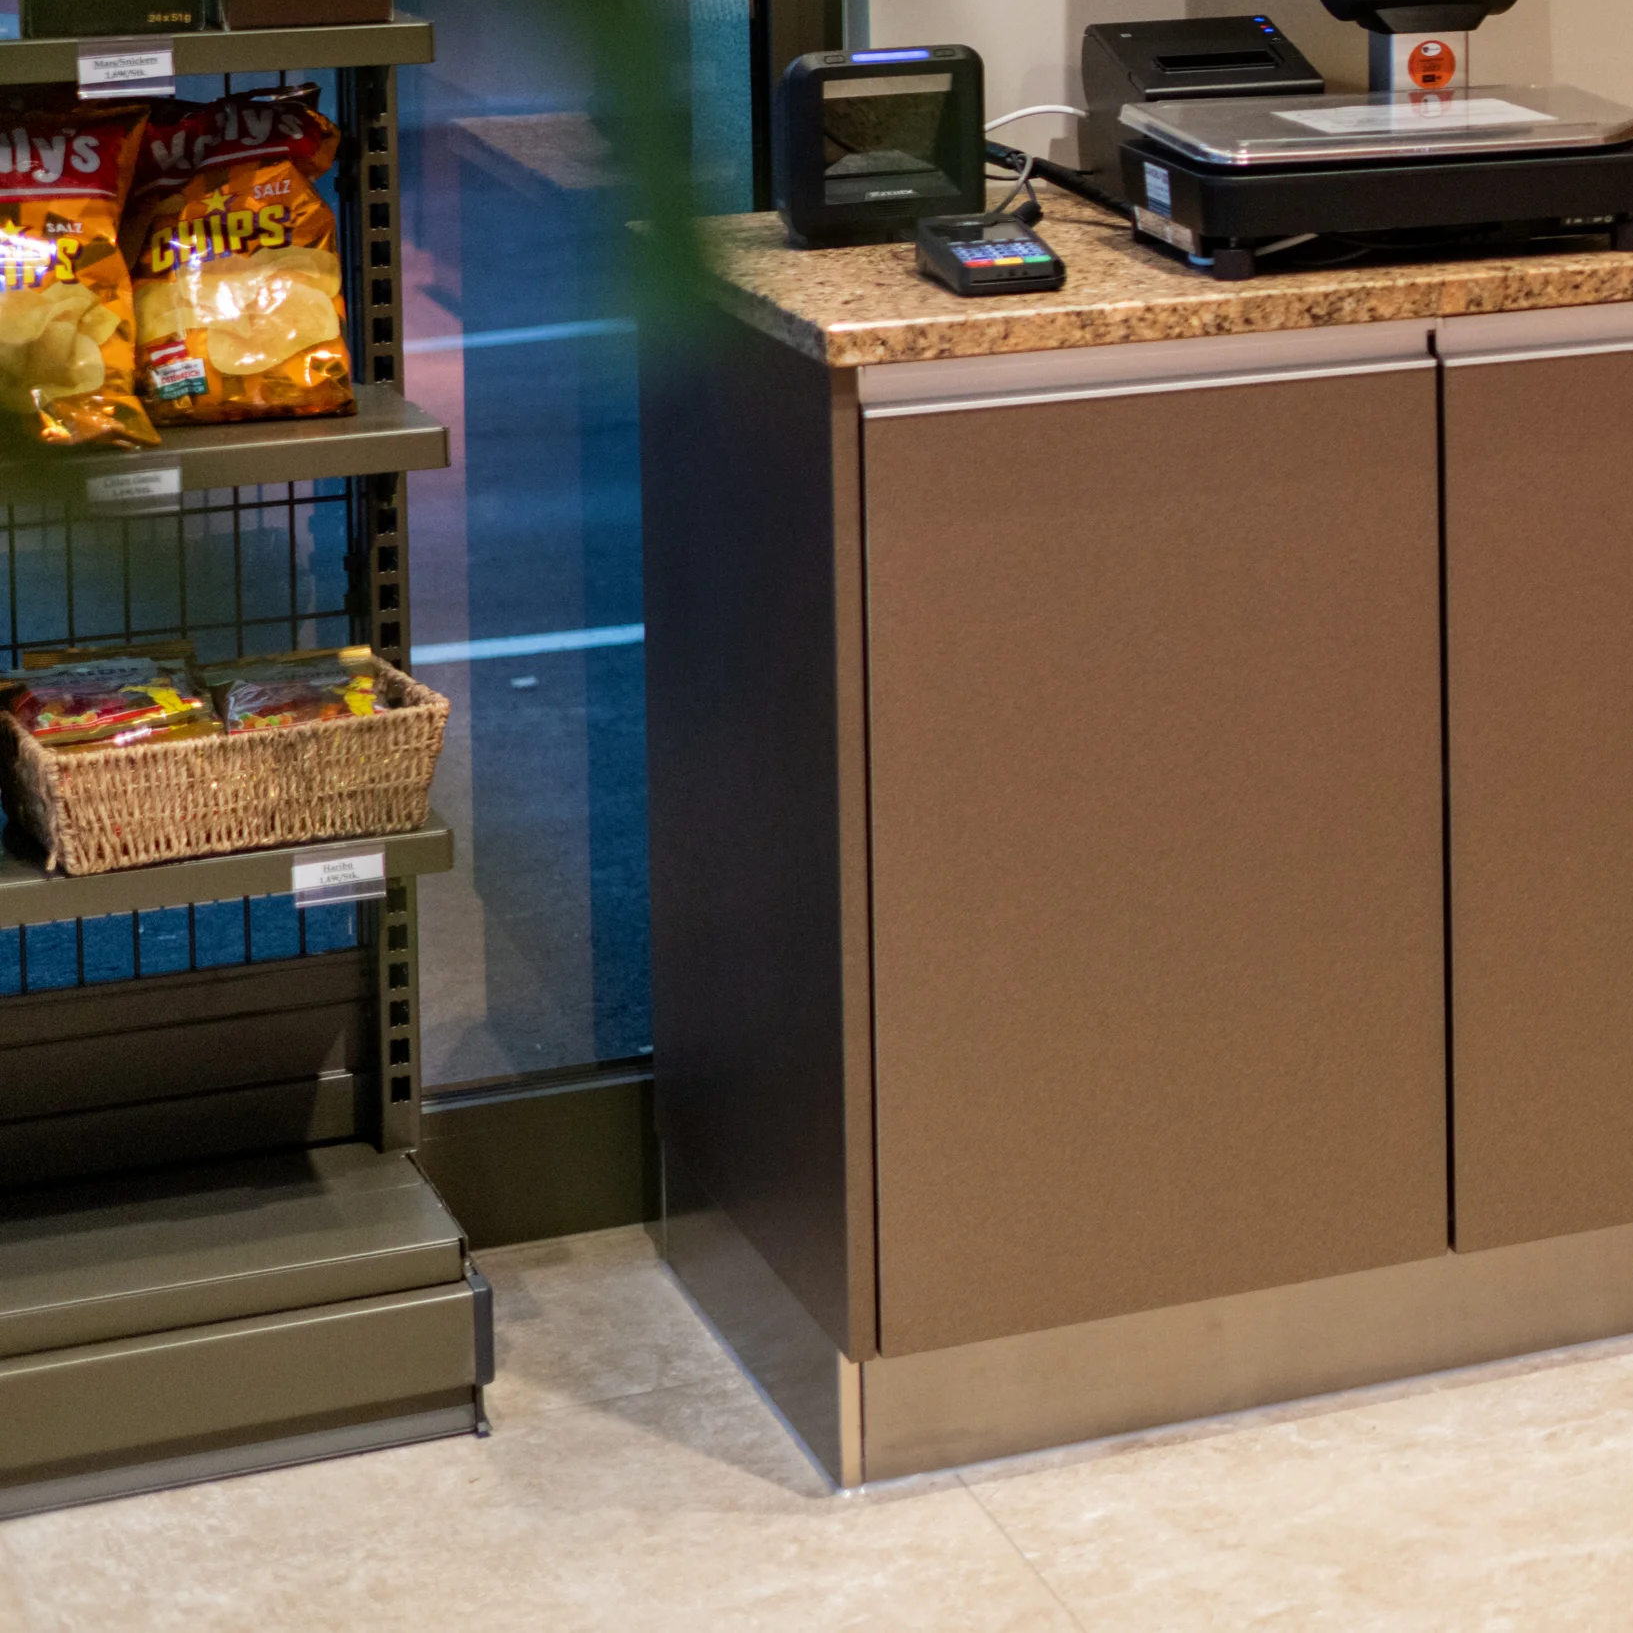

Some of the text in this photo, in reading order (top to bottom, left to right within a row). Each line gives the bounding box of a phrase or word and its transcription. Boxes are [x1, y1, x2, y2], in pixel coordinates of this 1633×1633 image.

[253, 179, 292, 200] SALZ
[46, 221, 84, 234] SALZ
[151, 203, 293, 274] CHIPS
[323, 862, 354, 873] Haribo
